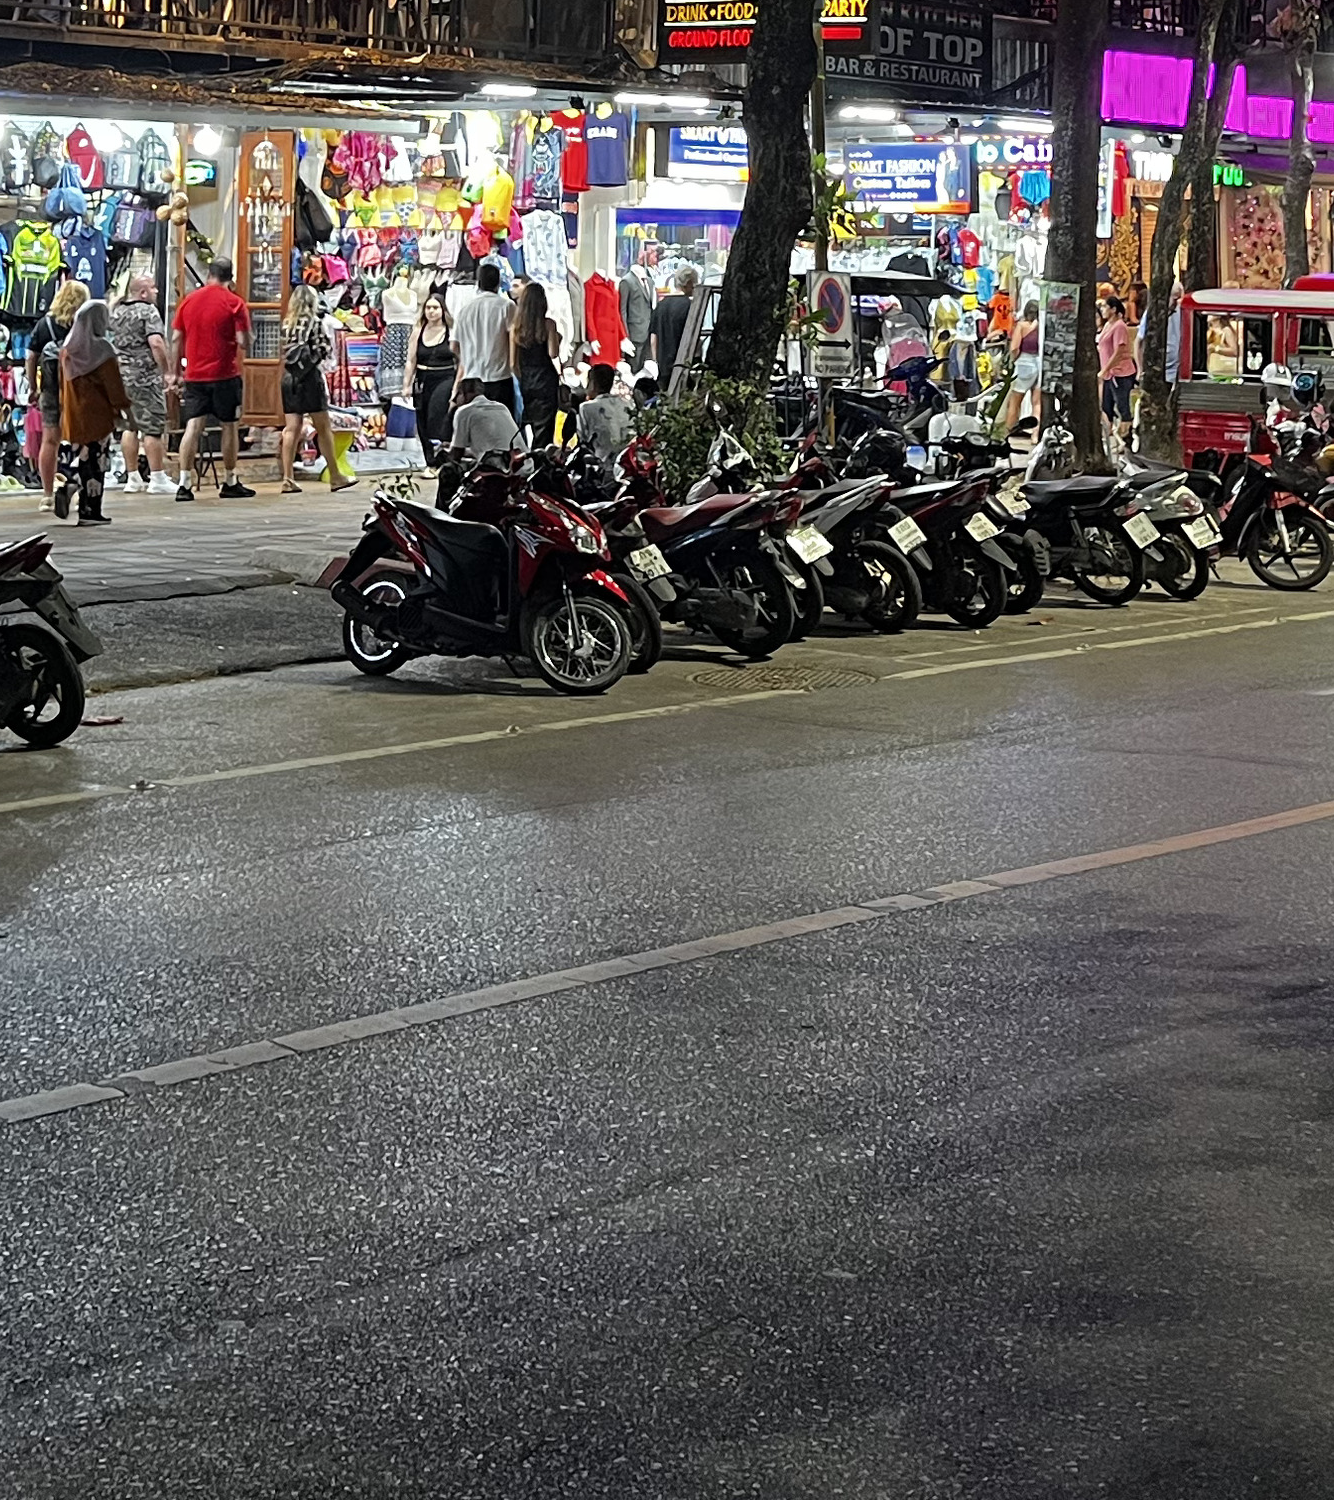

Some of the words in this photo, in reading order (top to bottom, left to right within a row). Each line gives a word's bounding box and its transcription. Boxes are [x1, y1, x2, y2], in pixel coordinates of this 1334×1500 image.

[666, 3, 709, 22] DRINK
[900, 3, 983, 30] KITCHEN
[668, 29, 717, 48] GROUND
[719, 29, 754, 47] FLOO
[923, 30, 984, 66] TOP
[825, 55, 860, 75] BAR
[863, 60, 875, 77] &
[879, 61, 983, 90] RESTAURANT
[848, 160, 884, 174] SMART
[885, 158, 937, 174] FASHION
